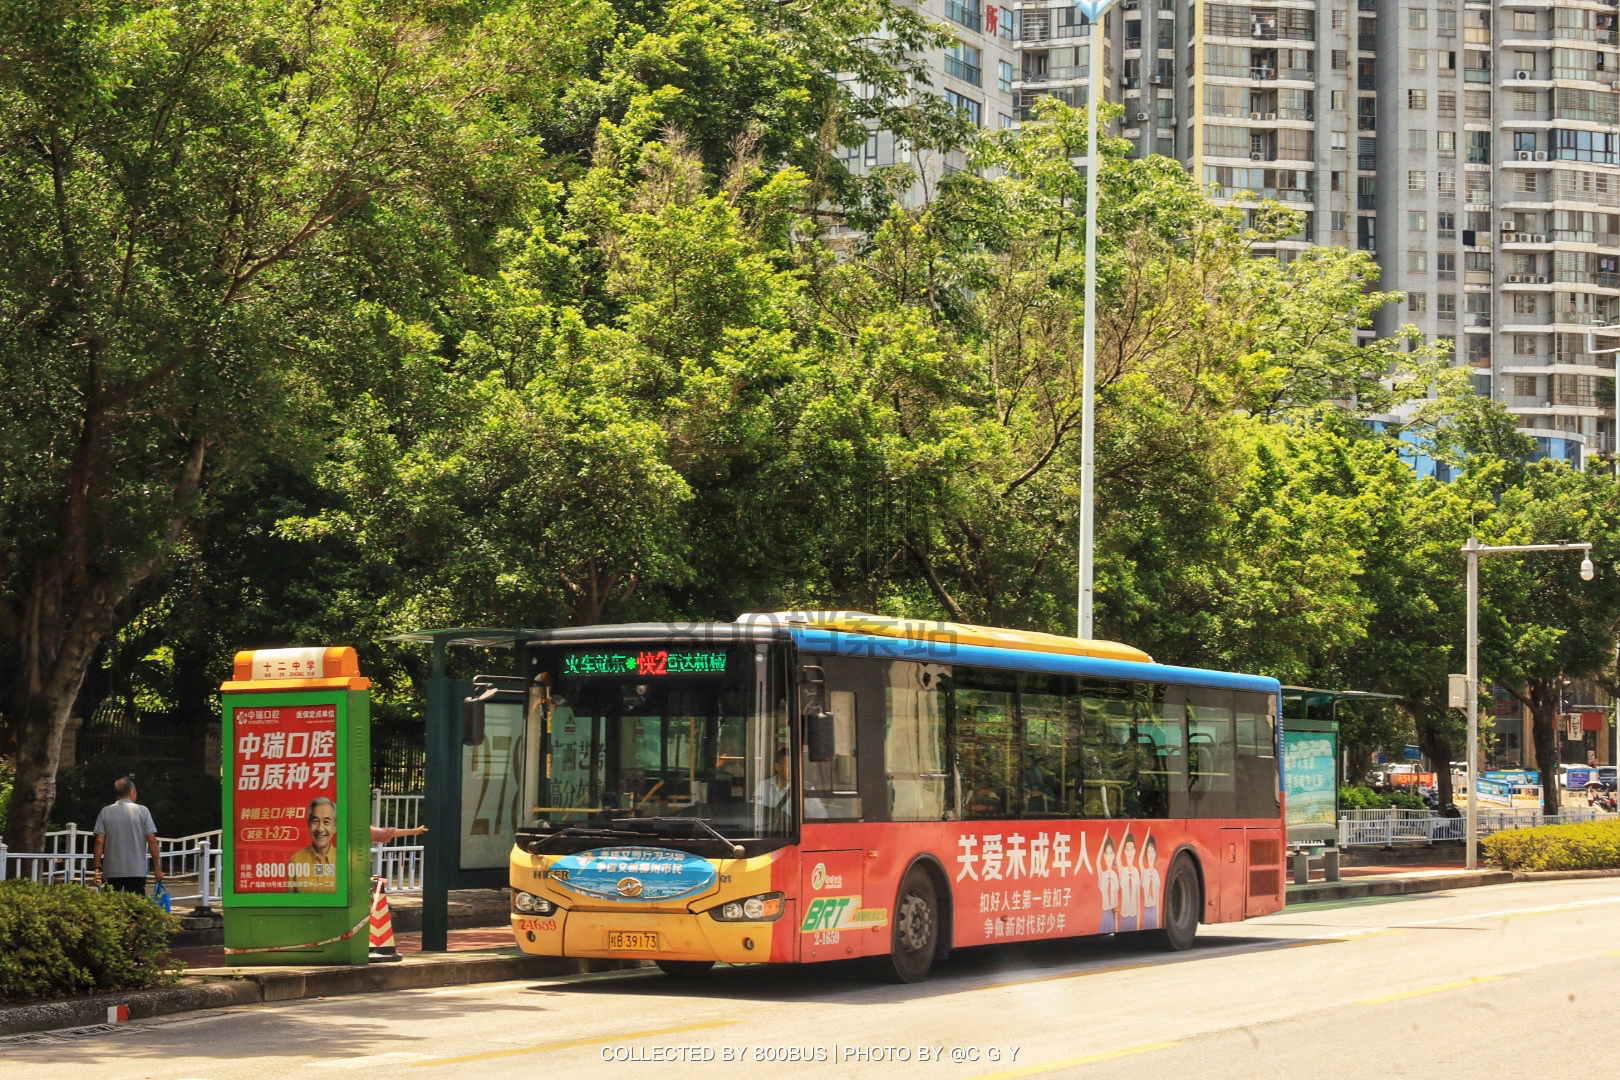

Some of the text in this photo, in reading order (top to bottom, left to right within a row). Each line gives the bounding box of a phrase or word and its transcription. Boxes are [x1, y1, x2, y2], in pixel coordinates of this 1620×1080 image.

[263, 660, 315, 672] 十二中学
[564, 654, 626, 674] 火车站东
[637, 651, 668, 675] 快2
[238, 730, 336, 760] 中瑞口腔
[237, 762, 336, 790] 品质种牙
[956, 831, 1093, 882] 关爱未成年人
[979, 888, 1072, 913] 扣好人生第一粒扣子
[519, 919, 557, 931] 2-1659
[802, 898, 851, 930] BRT
[984, 913, 1066, 938] 争做新时代好少年
[814, 931, 840, 945] 2-1659
